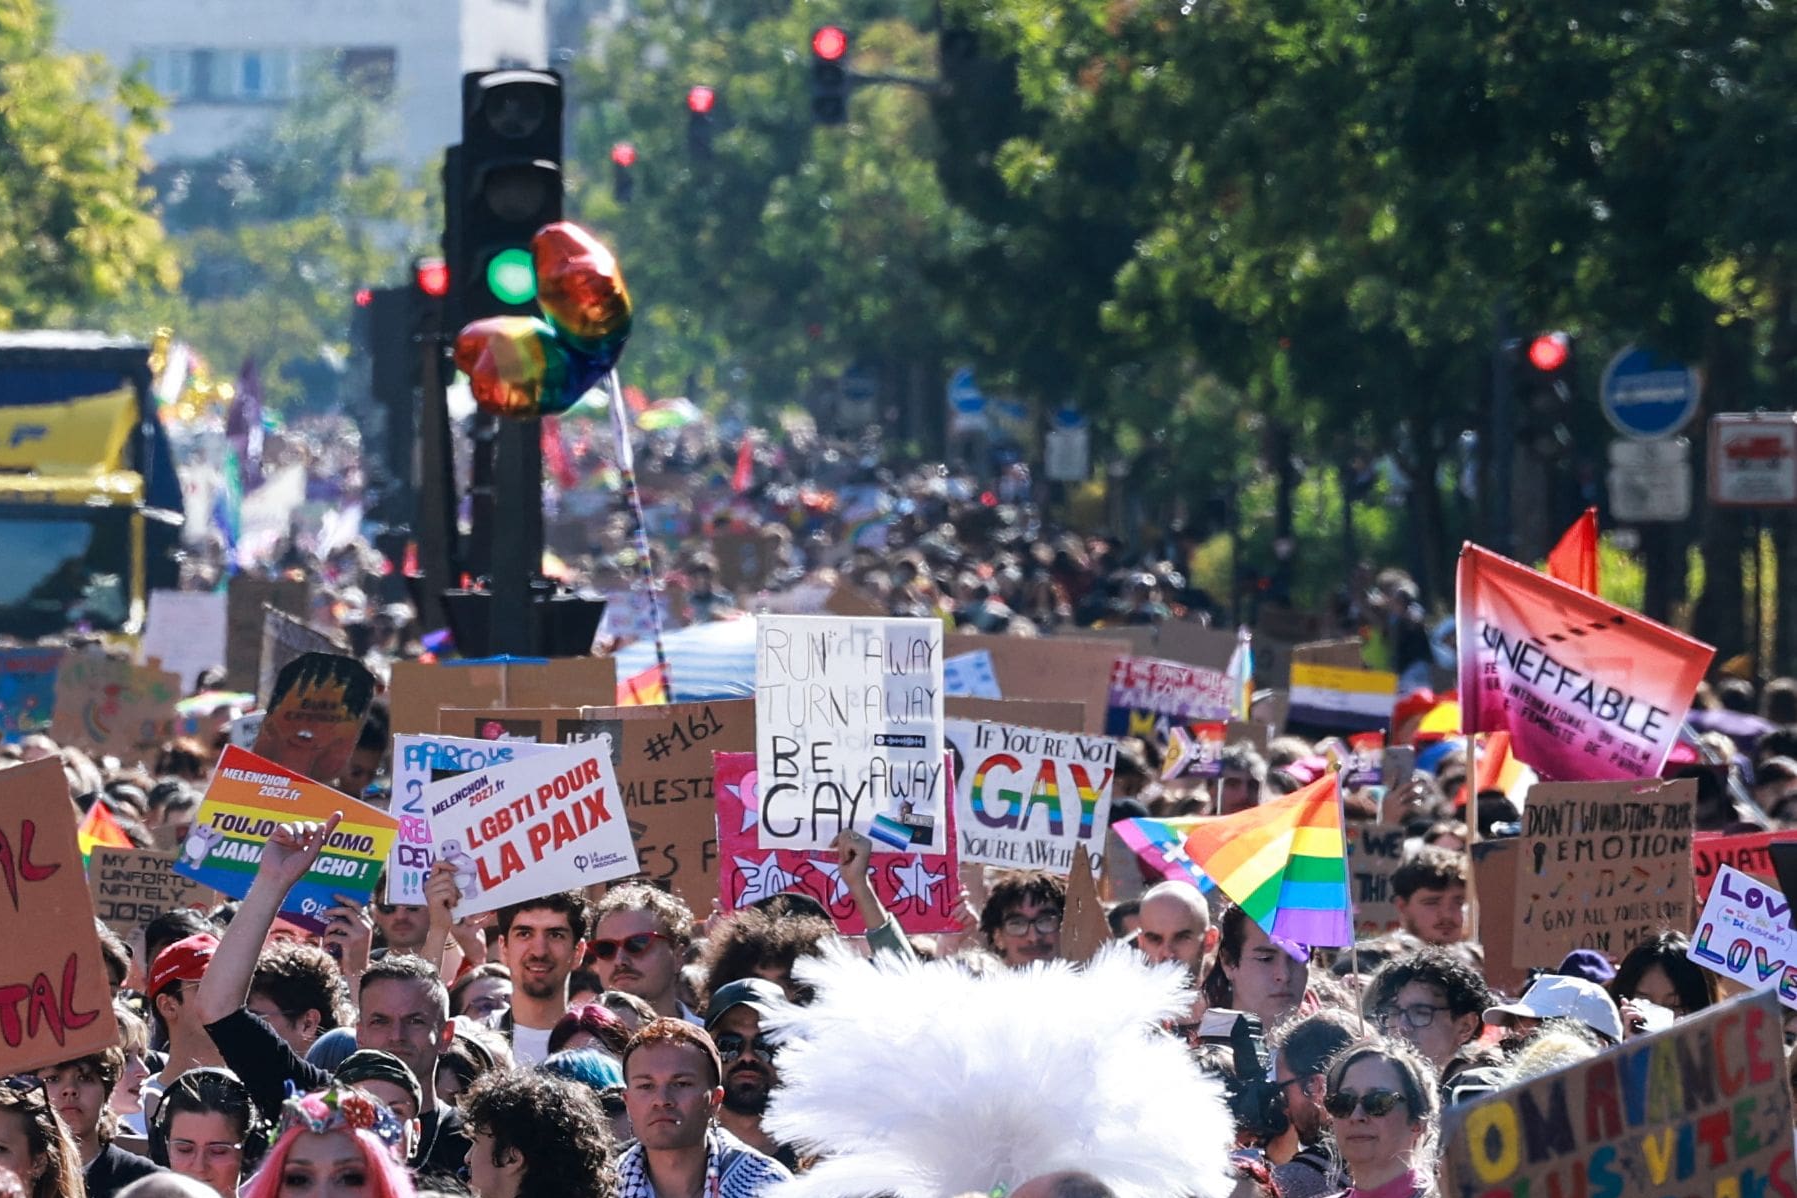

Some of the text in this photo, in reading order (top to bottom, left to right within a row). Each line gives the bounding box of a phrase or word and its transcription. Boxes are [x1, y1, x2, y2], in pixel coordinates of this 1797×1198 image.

[765, 628, 939, 681] RUN AWAY
[759, 683, 938, 728] TURN AWAY
[643, 706, 724, 762] #161
[975, 725, 995, 749] IF
[1073, 737, 1116, 764] NOT
[221, 767, 291, 788] MELENCHON
[772, 735, 833, 778] BE
[258, 785, 301, 800] 2027.fr
[401, 779, 425, 814] 2
[431, 775, 489, 817] MELENCHON
[465, 758, 601, 850] LGBTI POUR
[468, 779, 505, 807] 2027.fr
[762, 756, 942, 842] GAY AWAY
[971, 753, 1113, 839] GAY
[211, 812, 279, 837] TOUJO
[474, 787, 612, 892] LA PAIX
[103, 853, 130, 867] MY
[309, 856, 357, 878] ACHO
[1034, 840, 1102, 870] WEIO
[1557, 835, 1689, 862] EMOTION
[100, 882, 185, 902] NATELY
[731, 858, 951, 920] FASCSM
[1720, 873, 1789, 919] LOV
[1542, 908, 1575, 931] GAY
[1584, 905, 1608, 924] ALL
[1695, 923, 1797, 1000] LOVE
[1584, 1007, 1774, 1143] AVANCE
[1642, 1096, 1760, 1186] VITE
